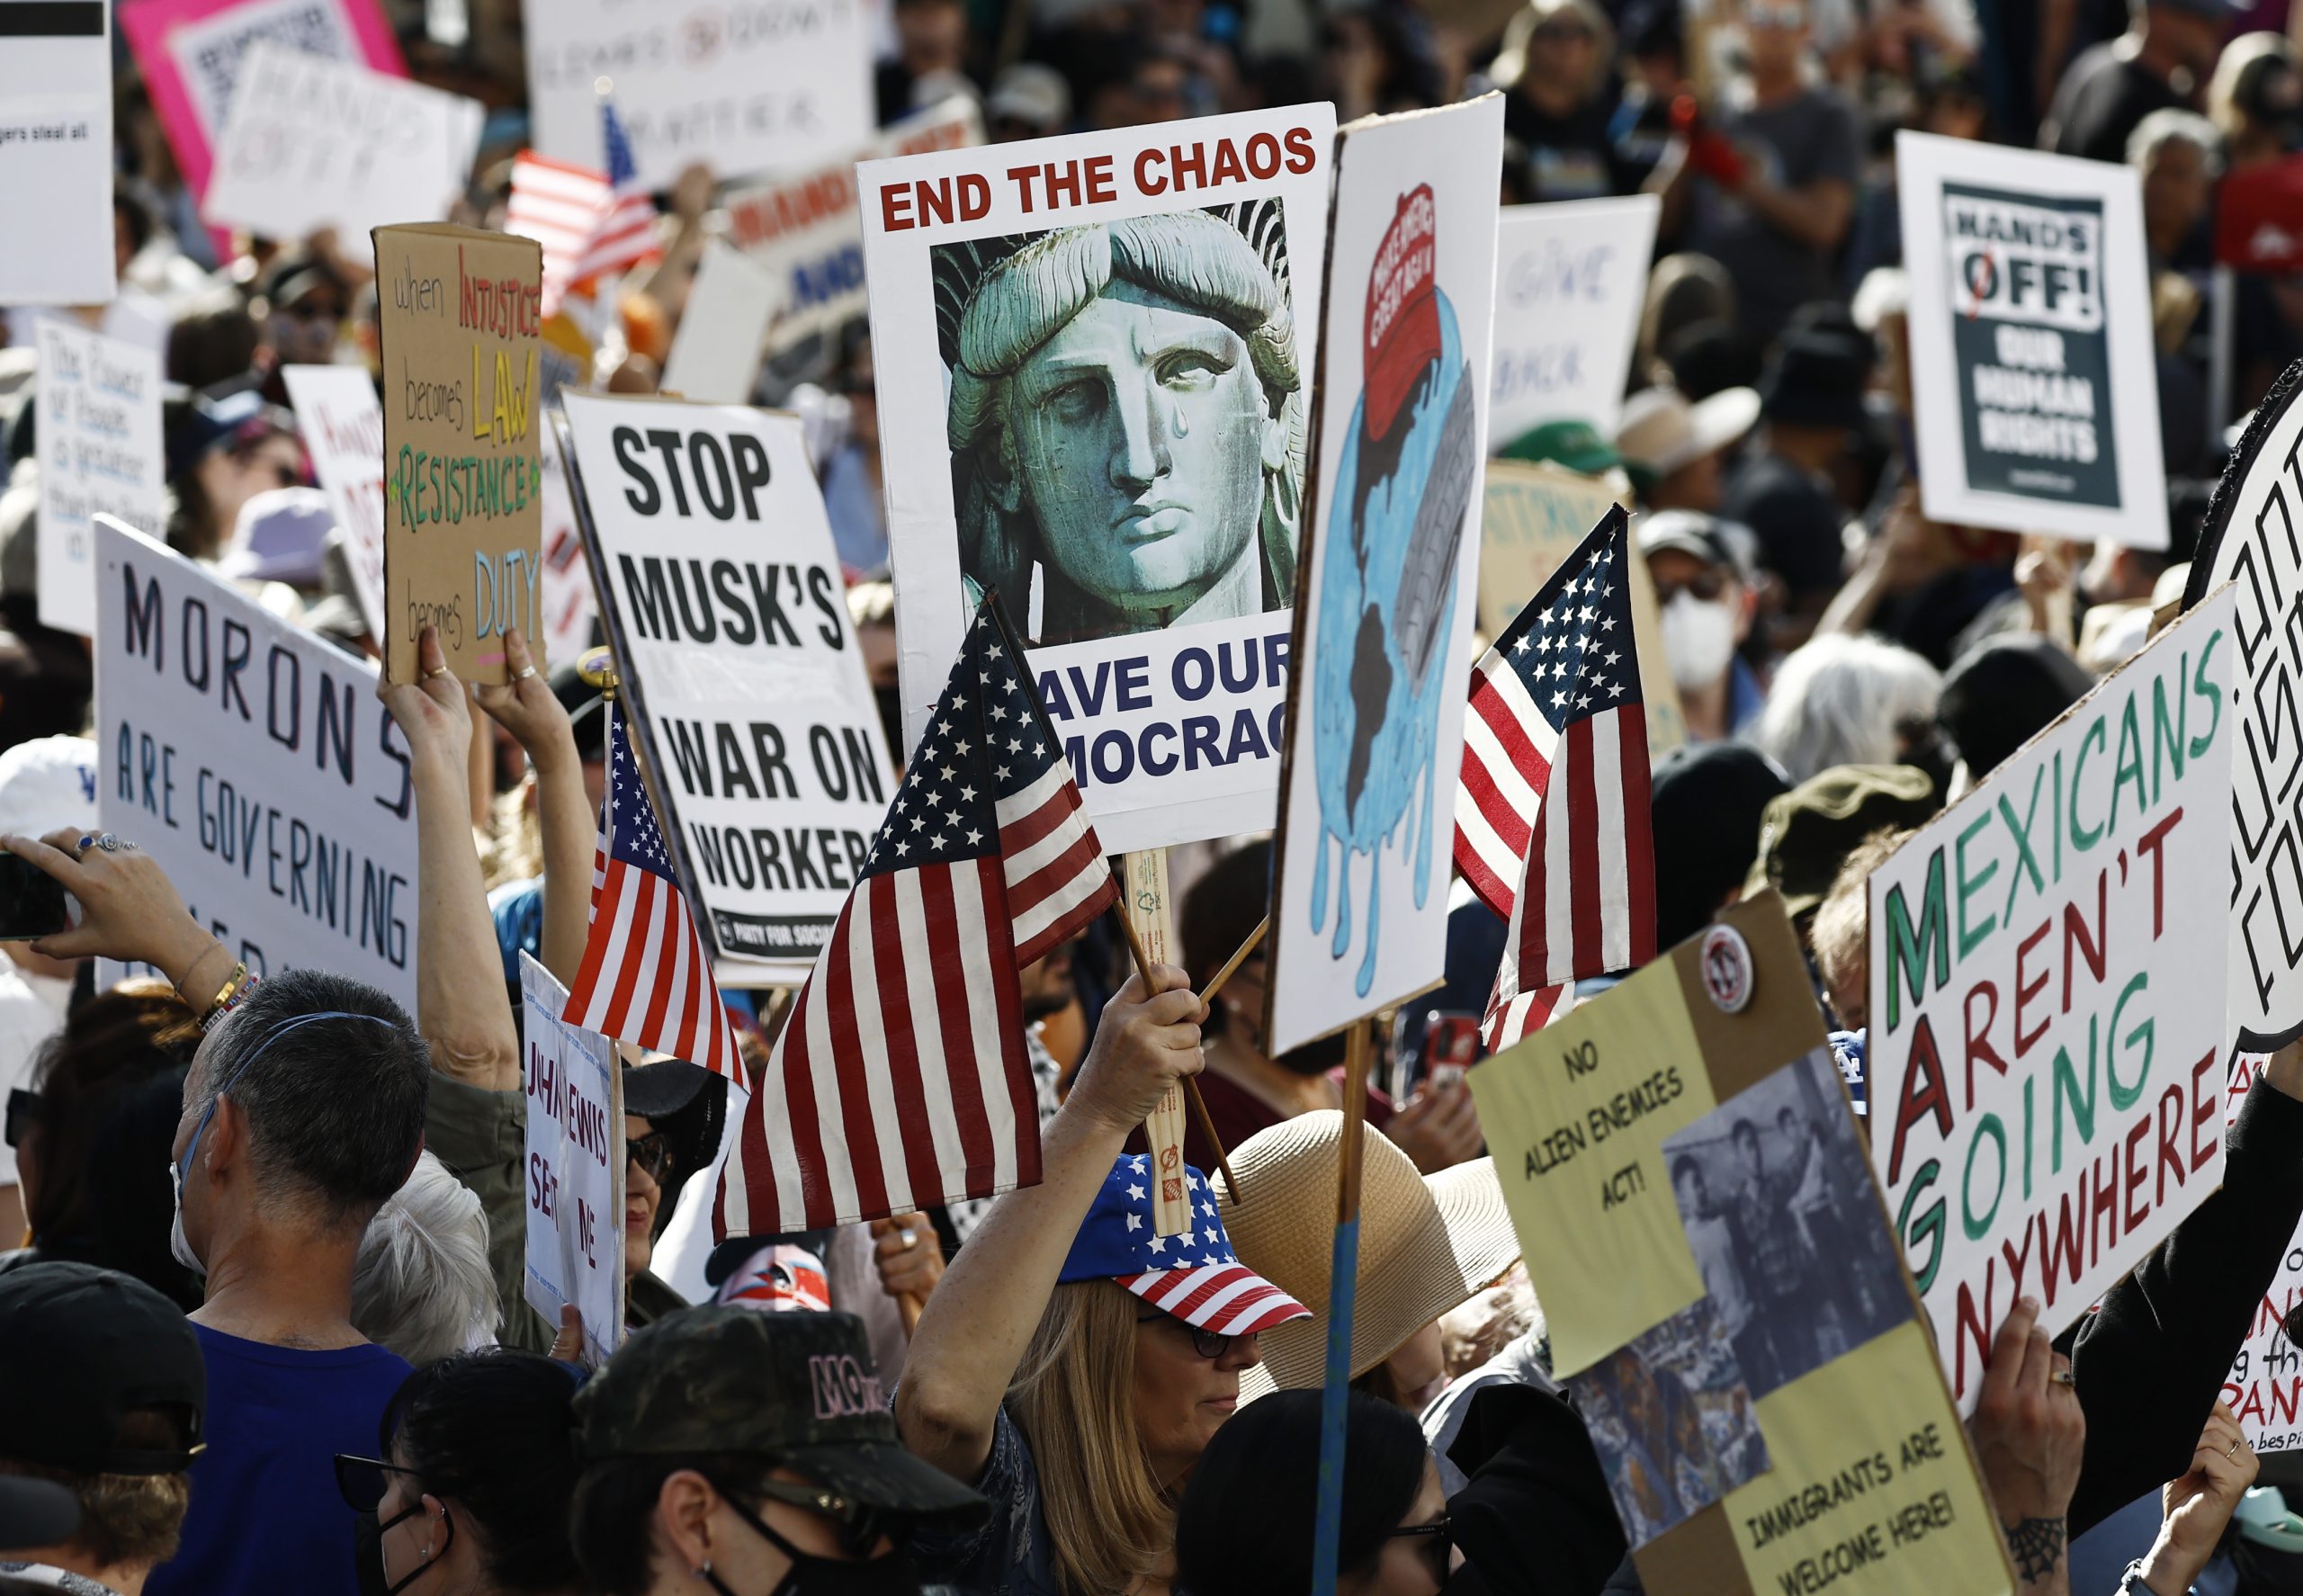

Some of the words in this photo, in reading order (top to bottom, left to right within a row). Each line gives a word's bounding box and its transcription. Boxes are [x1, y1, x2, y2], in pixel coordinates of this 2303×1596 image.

[880, 173, 990, 232] END
[1008, 156, 1117, 213] THE
[1134, 127, 1316, 196] CHAOS
[1955, 207, 2088, 253] HANDS
[394, 255, 444, 317] when
[458, 243, 541, 341] INJUSTICE
[1962, 251, 2093, 316] OFF!
[404, 355, 464, 432] becomes
[472, 344, 533, 448] LAW
[1973, 363, 2095, 419] HUMAN
[1994, 325, 2066, 371] OUR
[613, 426, 771, 521] STOP
[1977, 408, 2099, 464] RIGHTS
[399, 444, 527, 533] RESISTANCE
[408, 578, 463, 650] becomes
[474, 549, 539, 643] DUTY
[617, 552, 845, 651] MUSK'S
[122, 561, 412, 821] MORONS
[1038, 656, 1153, 721] AVE
[1171, 632, 1292, 701] OUR
[661, 717, 799, 799] WAR
[810, 725, 885, 804] ON
[118, 720, 179, 829] ARE
[196, 767, 409, 970] GOVERNING
[690, 822, 877, 891] WORKER
[1886, 629, 2223, 1036] MEXICANS
[732, 921, 766, 946] PARTY
[766, 925, 793, 946] FOR
[1887, 805, 2184, 1188] AREN'T
[527, 1041, 563, 1125] JHN
[568, 1082, 607, 1168] EWIS
[1562, 1040, 1600, 1082] NO
[1524, 1120, 1586, 1180] ALIEN
[1588, 1066, 1685, 1144] ENEMIES
[1896, 971, 2155, 1297] GOING
[531, 1152, 559, 1233] SET
[1601, 1161, 1646, 1212] ACT!
[1934, 1045, 2218, 1400] NYWHERE
[1745, 1452, 1893, 1550] IMMIGRANTS
[1899, 1422, 1945, 1472] ARE
[1778, 1524, 1886, 1596] WELCOME
[1886, 1490, 1957, 1548] HERE!
